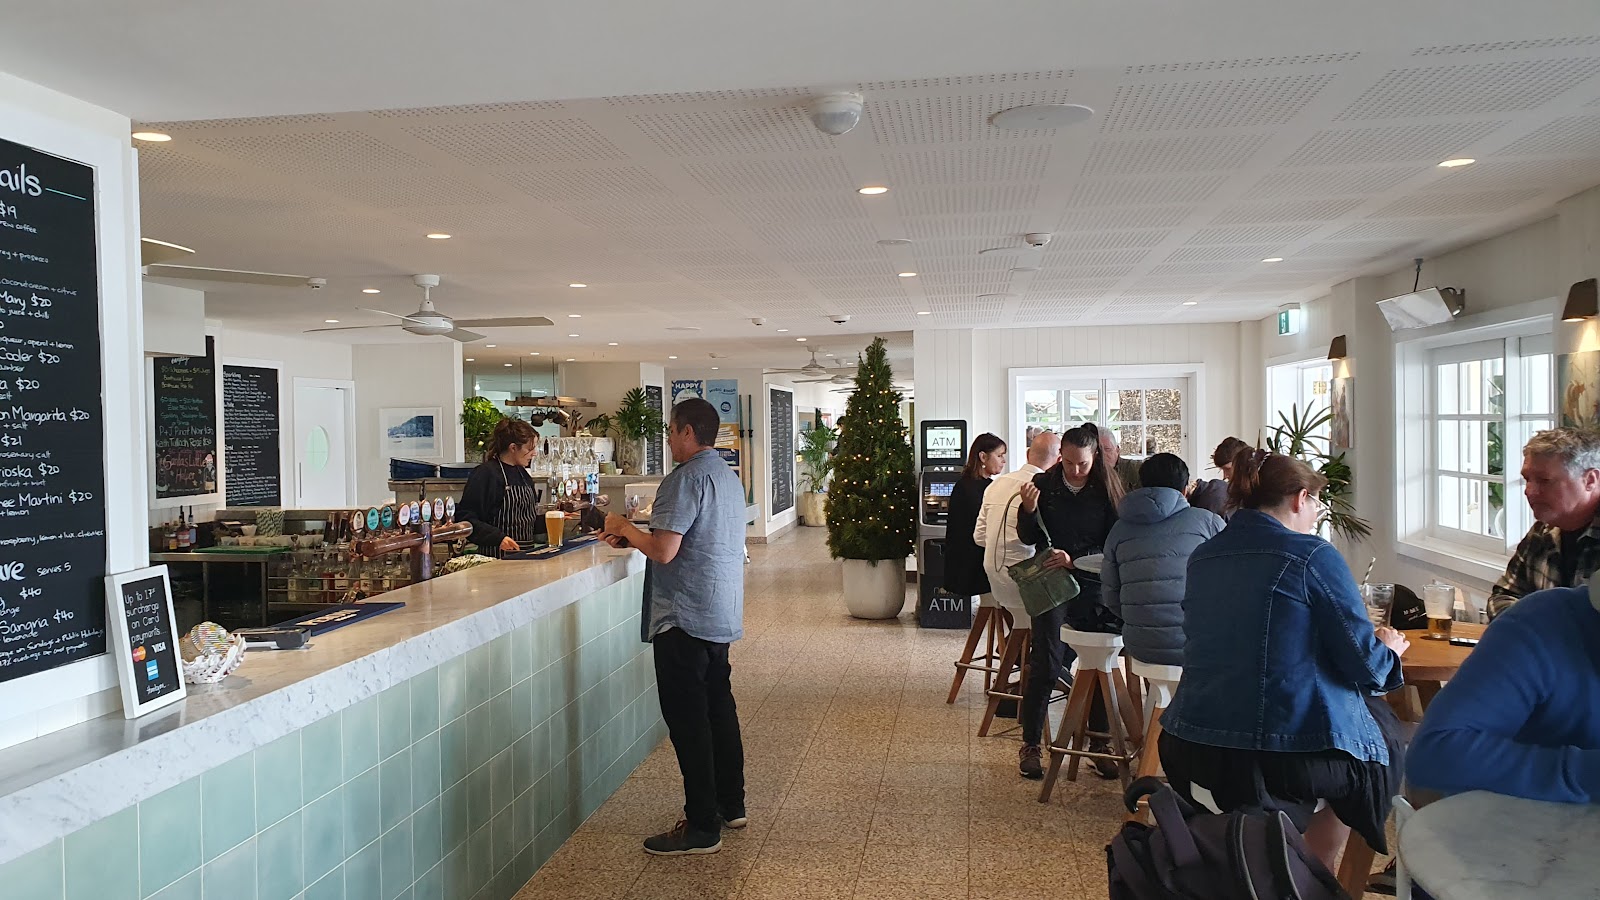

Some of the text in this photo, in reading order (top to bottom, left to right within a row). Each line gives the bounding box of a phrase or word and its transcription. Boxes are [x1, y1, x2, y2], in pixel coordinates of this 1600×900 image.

[30, 292, 52, 307] $20
[38, 349, 60, 364] $20
[15, 377, 40, 392] $20
[11, 405, 68, 425] Margarita
[69, 407, 90, 422] $20
[1, 433, 22, 447] $21
[931, 437, 956, 447] ATM
[38, 462, 60, 476] $20
[18, 492, 63, 507] Martini
[68, 489, 93, 504] $20
[6, 508, 30, 517] lemon
[64, 561, 72, 572] 5
[19, 586, 42, 600] $40
[124, 593, 134, 607] Up
[928, 597, 964, 612] ATM
[0, 608, 74, 636] Sangria $40
[142, 611, 160, 627] Card
